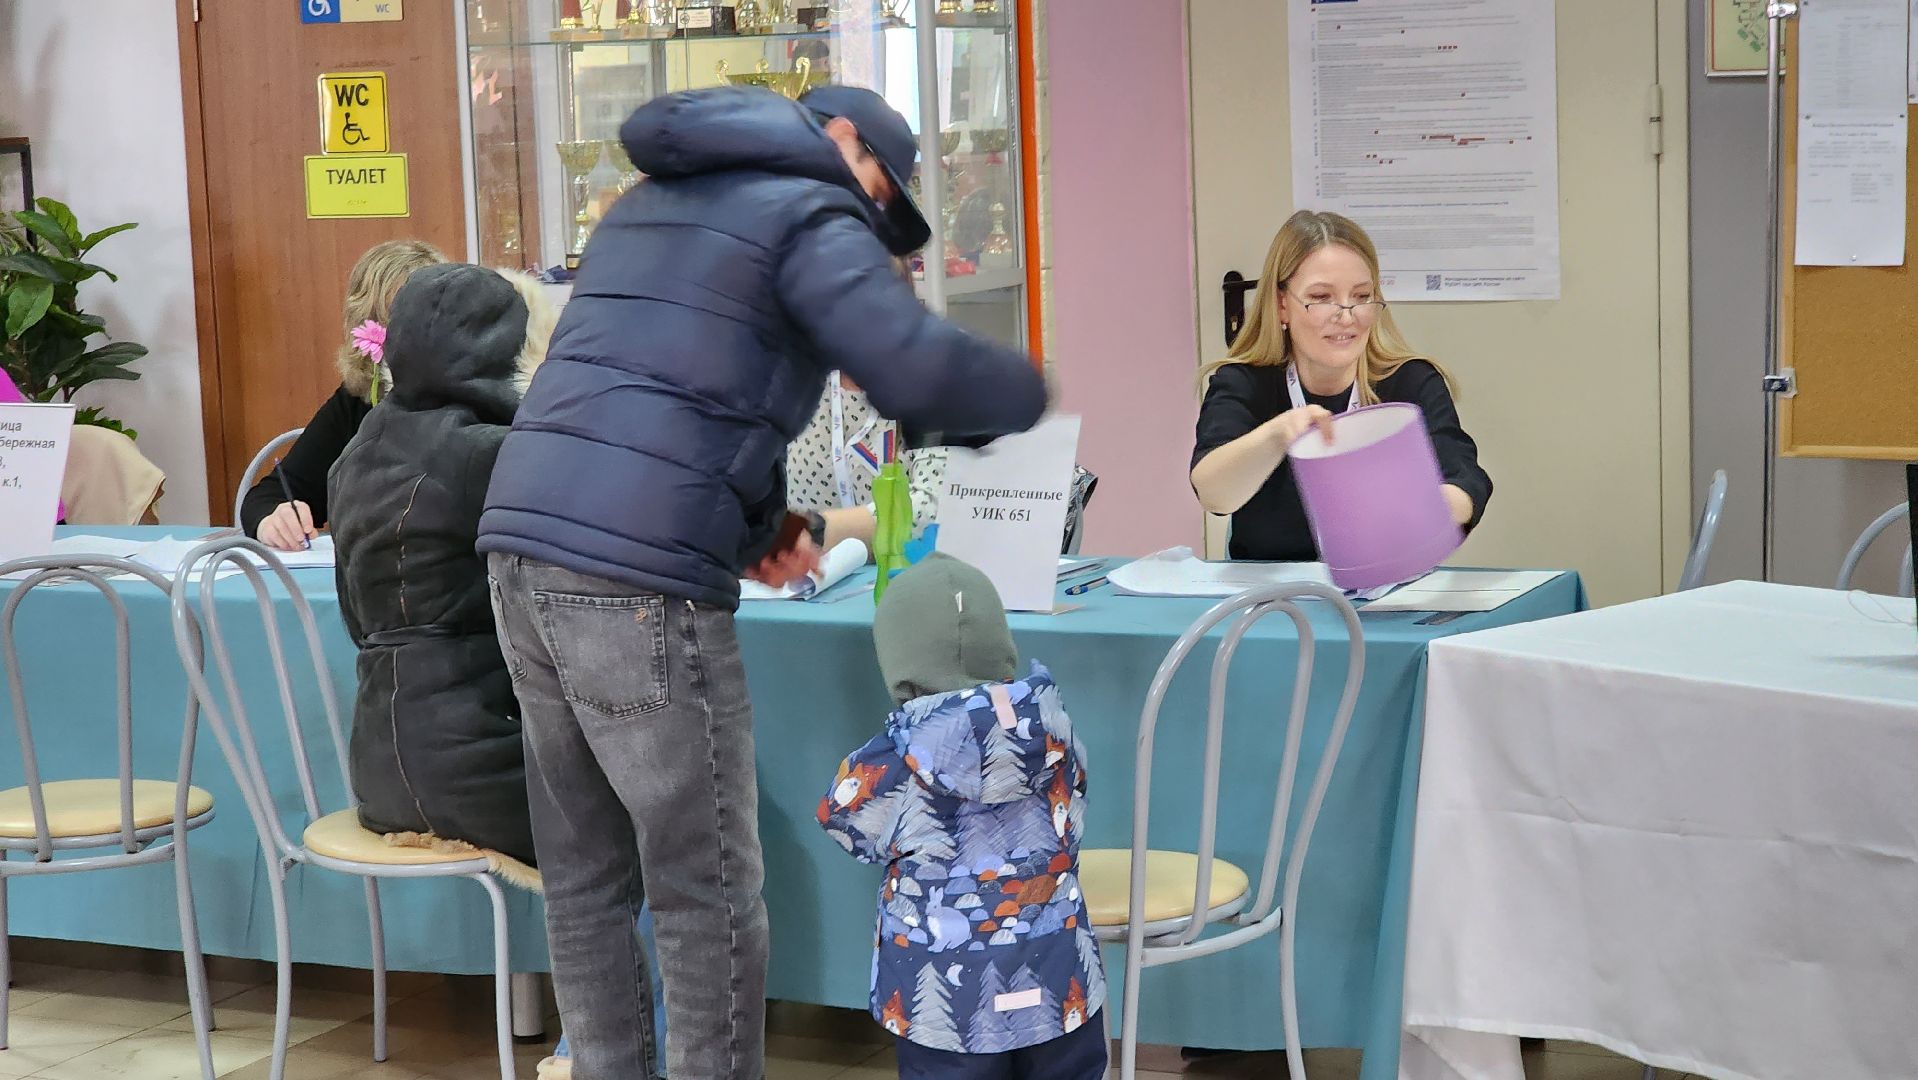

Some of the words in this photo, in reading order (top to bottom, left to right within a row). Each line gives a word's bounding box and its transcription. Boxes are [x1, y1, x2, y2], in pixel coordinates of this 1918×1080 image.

[375, 4, 390, 13] WC
[334, 83, 369, 107] WC
[326, 168, 386, 185] ТУАЛЕТ
[2, 475, 22, 489] к.1,
[949, 483, 1063, 501] Прикрепленные
[971, 506, 1005, 521] УИК
[1009, 508, 1031, 522] 651
